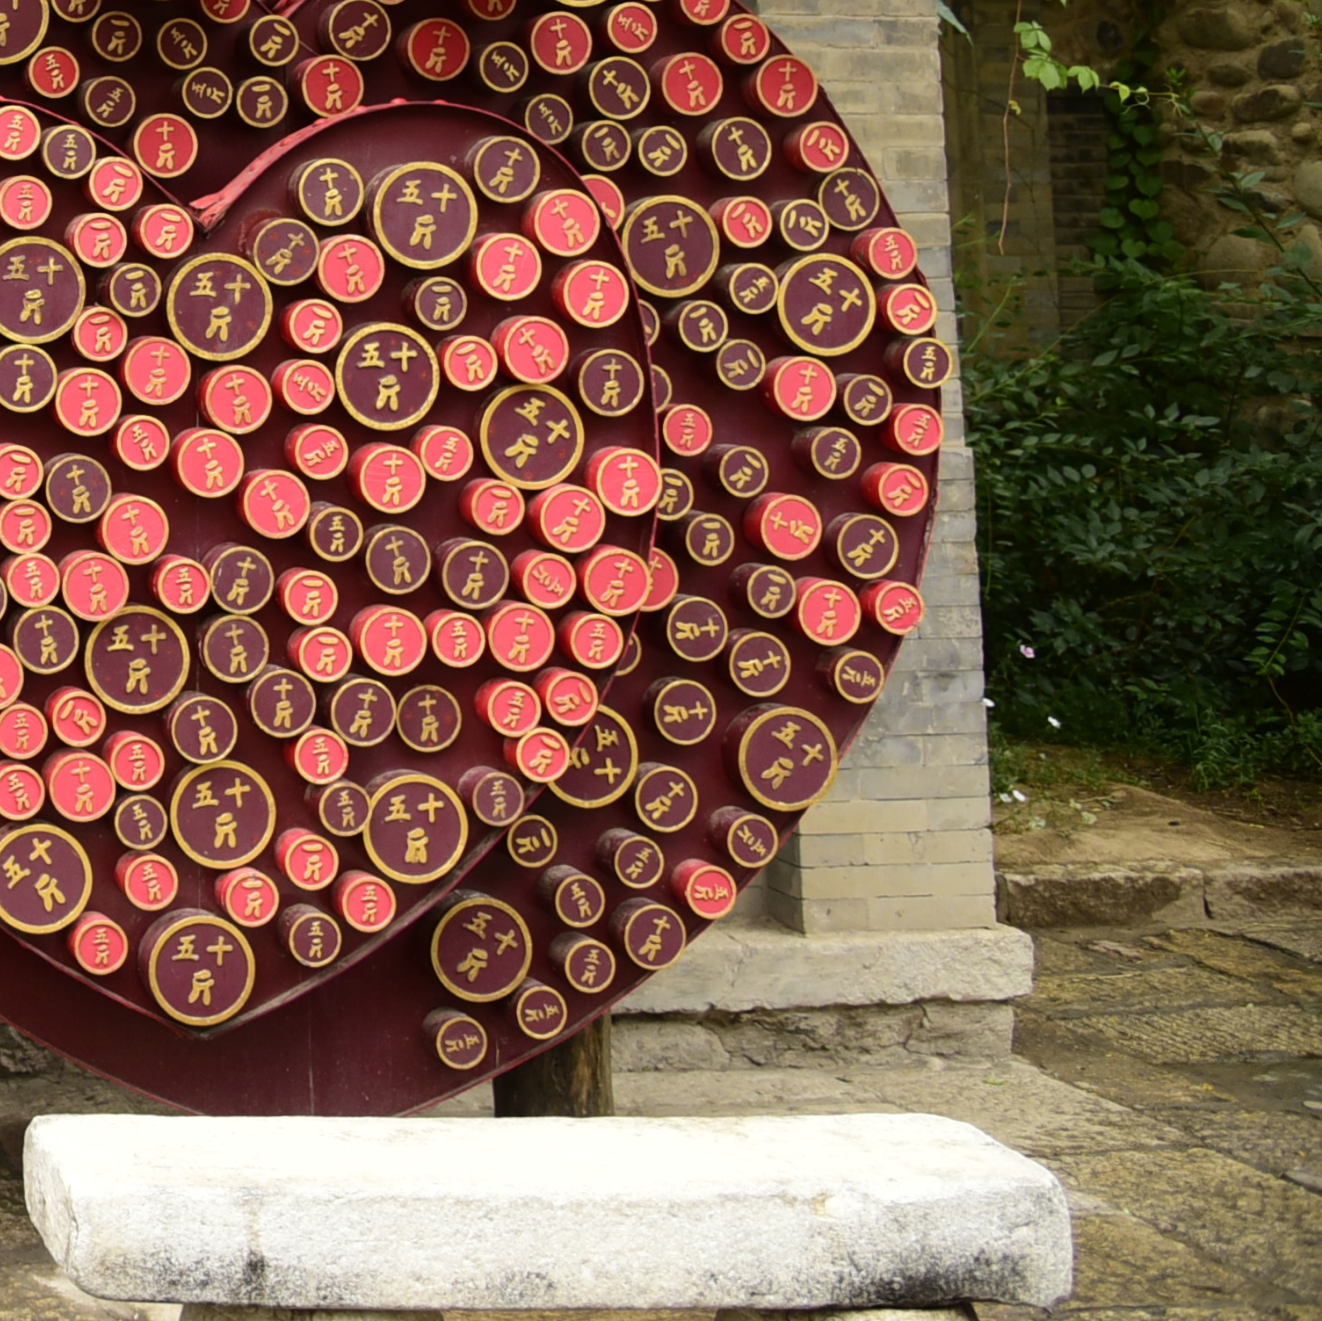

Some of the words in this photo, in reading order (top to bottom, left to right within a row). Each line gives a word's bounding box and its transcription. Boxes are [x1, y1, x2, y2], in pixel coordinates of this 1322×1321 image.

[107, 19, 130, 55] 一斤
[258, 21, 292, 60] 一斤
[338, 12, 379, 50] 十斤
[550, 18, 572, 66] 十斤
[734, 21, 757, 55] 一斤
[46, 54, 65, 90] 五斤
[322, 62, 343, 110] 十斤
[602, 69, 642, 111] 十斤
[777, 62, 797, 110] 十斤
[96, 87, 125, 119] 五斤
[251, 82, 274, 120] 一斤
[3, 113, 25, 152] 五斤
[63, 133, 80, 171] 五斤
[727, 125, 760, 174] 十斤
[318, 167, 345, 218] 十斤
[489, 148, 525, 195] 十斤
[833, 177, 868, 223] 十斤
[91, 221, 113, 259] 一斤
[156, 212, 183, 251] 一斤
[552, 199, 587, 248] 十斤
[339, 244, 366, 293] 十斤
[493, 242, 525, 292] 十斤
[886, 234, 904, 271] 五斤
[582, 269, 611, 320] 十斤
[91, 315, 113, 352] 一斤
[303, 306, 334, 345] 一斤
[12, 353, 37, 406] 十斤
[144, 345, 171, 397] 十斤
[456, 342, 486, 382] 一斤
[600, 359, 624, 409] 十斤
[79, 375, 100, 428] 十斤
[226, 374, 253, 425] 十斤
[680, 412, 696, 448] 五斤
[5, 454, 32, 492] 一斤
[196, 437, 225, 489] 十斤
[434, 436, 460, 472] 五斤
[66, 464, 94, 515] 十斤
[382, 453, 405, 506] 十斤
[618, 456, 641, 508] 十斤
[14, 507, 36, 545] 一斤
[261, 480, 296, 530] 十斤
[487, 488, 513, 527] 一斤
[552, 498, 592, 544] 十斤
[121, 504, 151, 556] 十斤
[847, 528, 887, 569] 十斤
[25, 560, 44, 599] 五斤
[226, 556, 258, 607] 十斤
[385, 536, 414, 586] 十斤
[462, 550, 491, 602] 十斤
[600, 559, 634, 607] 十斤
[84, 561, 108, 613] 十斤
[177, 566, 194, 605] 五斤
[816, 589, 843, 638] 十斤
[34, 614, 60, 666] 十斤
[383, 615, 405, 668] 十斤
[451, 620, 469, 658] 五斤
[508, 612, 536, 664] 十斤
[588, 623, 606, 660] 五斤
[60, 699, 98, 735] 一斤
[273, 678, 295, 731] 十斤
[349, 688, 380, 739] 十斤
[417, 693, 440, 744] 十斤
[503, 691, 526, 728] 五斤
[14, 712, 30, 750] 五斤
[529, 735, 561, 775] 一斤
[8, 773, 31, 811] 五斤
[71, 761, 95, 813] 十斤
[338, 789, 357, 829] 五斤
[645, 781, 686, 822] 十斤
[132, 802, 155, 843] 五斤
[142, 863, 163, 901] 五斤
[362, 885, 379, 923] 五斤
[94, 928, 110, 965] 五斤
[638, 915, 673, 963] 十斤
